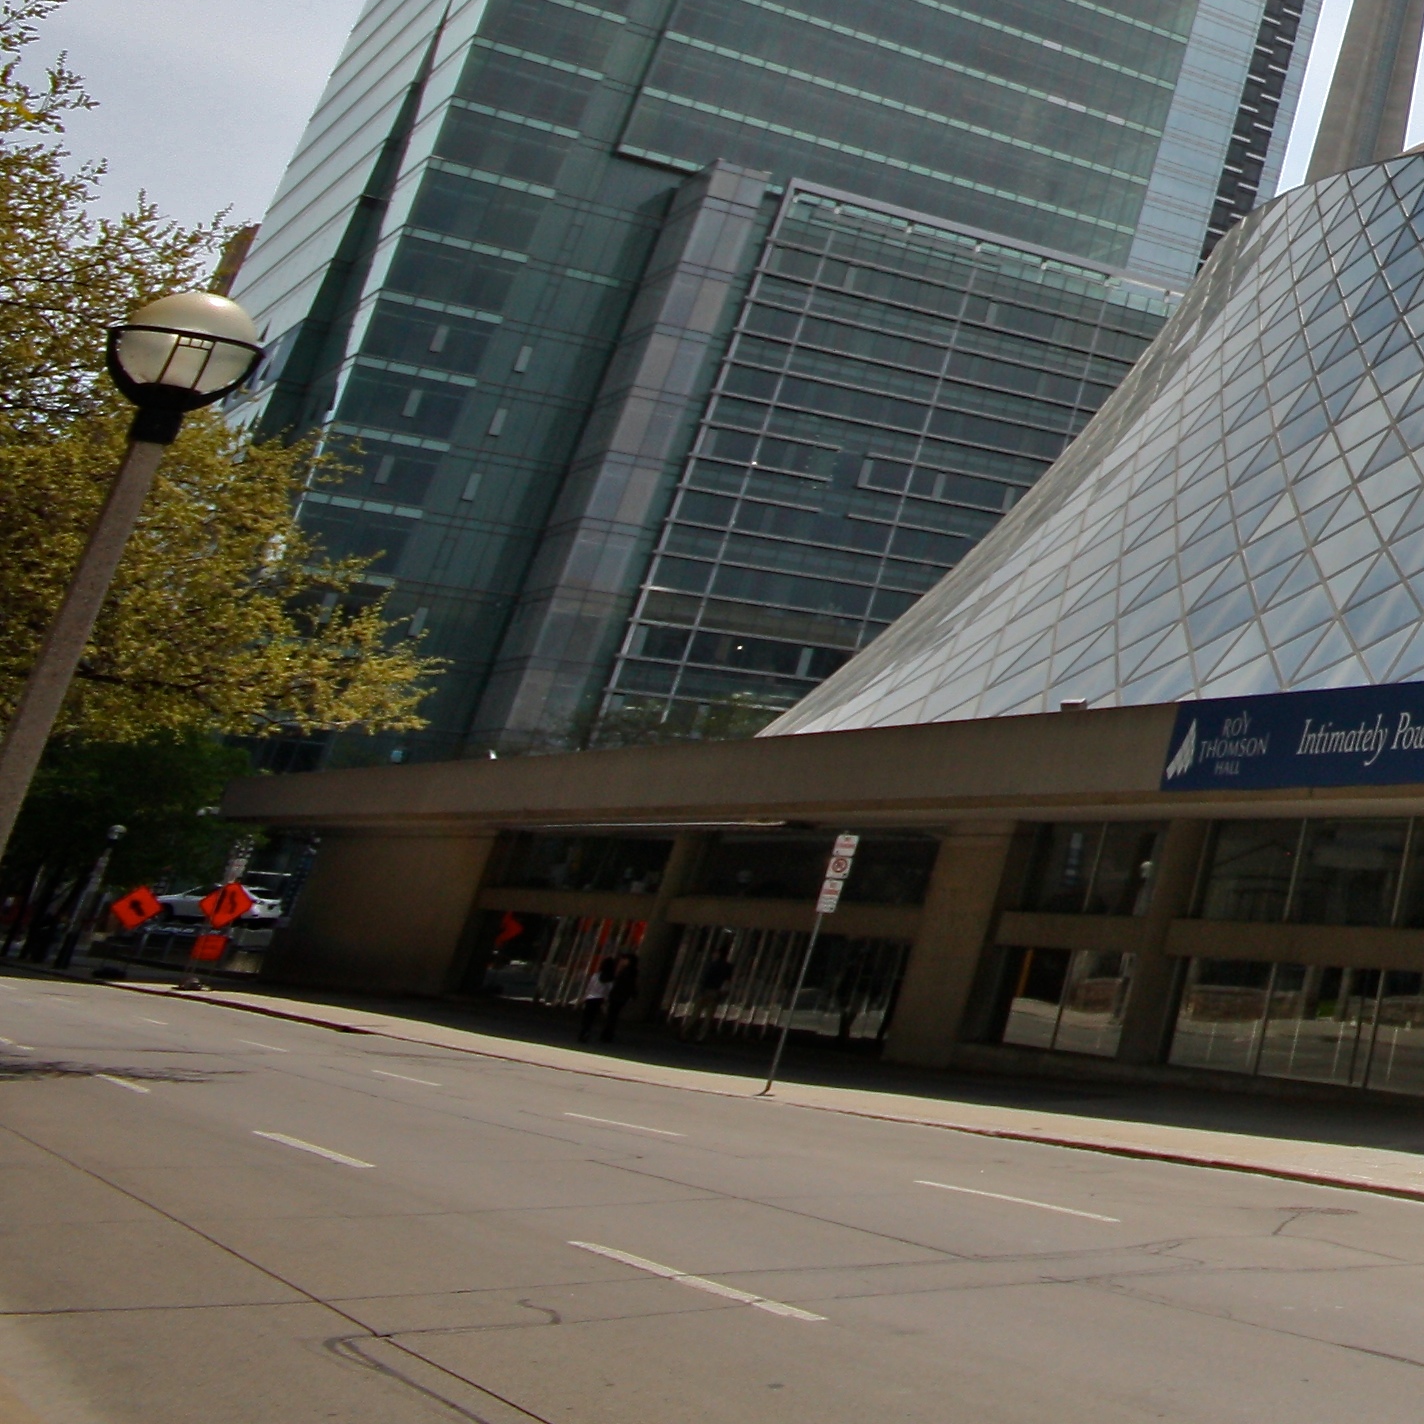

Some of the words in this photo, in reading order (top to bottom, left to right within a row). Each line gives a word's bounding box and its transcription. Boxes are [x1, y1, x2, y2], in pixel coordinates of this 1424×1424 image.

[1221, 710, 1252, 736] ROY
[1200, 732, 1269, 763] THOMSON
[1296, 713, 1388, 766] Intimately
[1214, 761, 1240, 775] HALL
